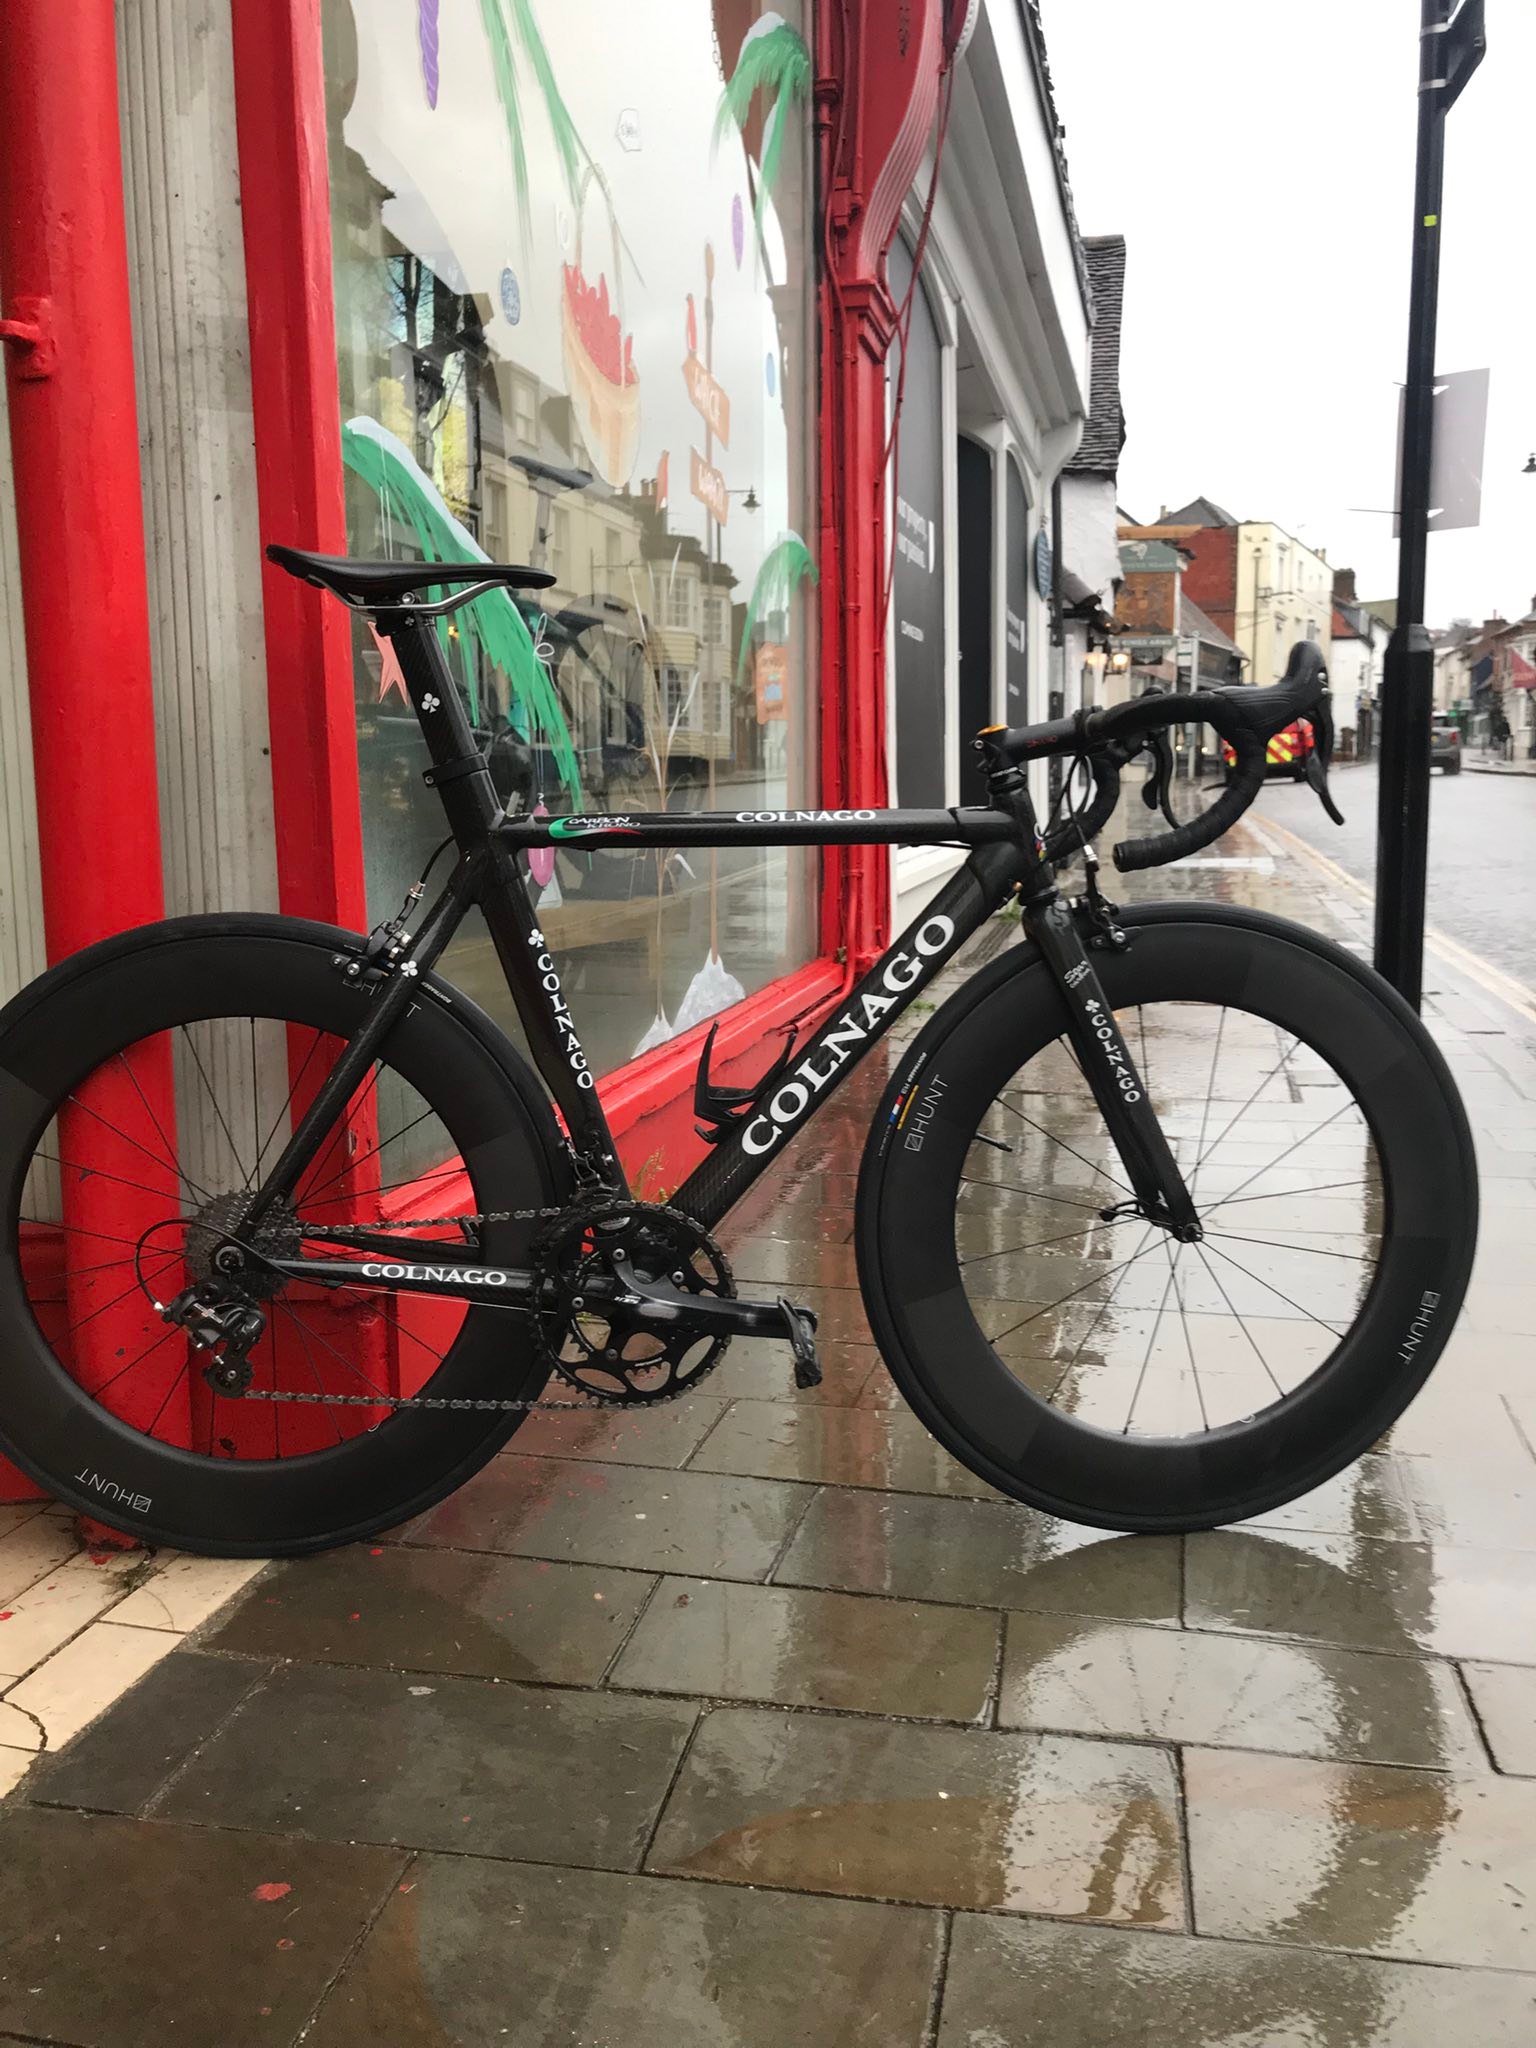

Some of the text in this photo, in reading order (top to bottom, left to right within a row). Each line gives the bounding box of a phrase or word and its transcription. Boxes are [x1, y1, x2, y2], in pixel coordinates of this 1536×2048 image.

[568, 816, 630, 824] CARBON
[735, 809, 876, 824] COLNAGO
[537, 953, 594, 1089] COLNAGO
[741, 914, 955, 1155] COLNAGO
[1091, 1013, 1141, 1103] COLNAGO
[910, 1074, 949, 1134] HUNT
[361, 1263, 507, 1286] COLNAGO
[1397, 1307, 1435, 1366] HUNT
[74, 1468, 135, 1506] HUNT
